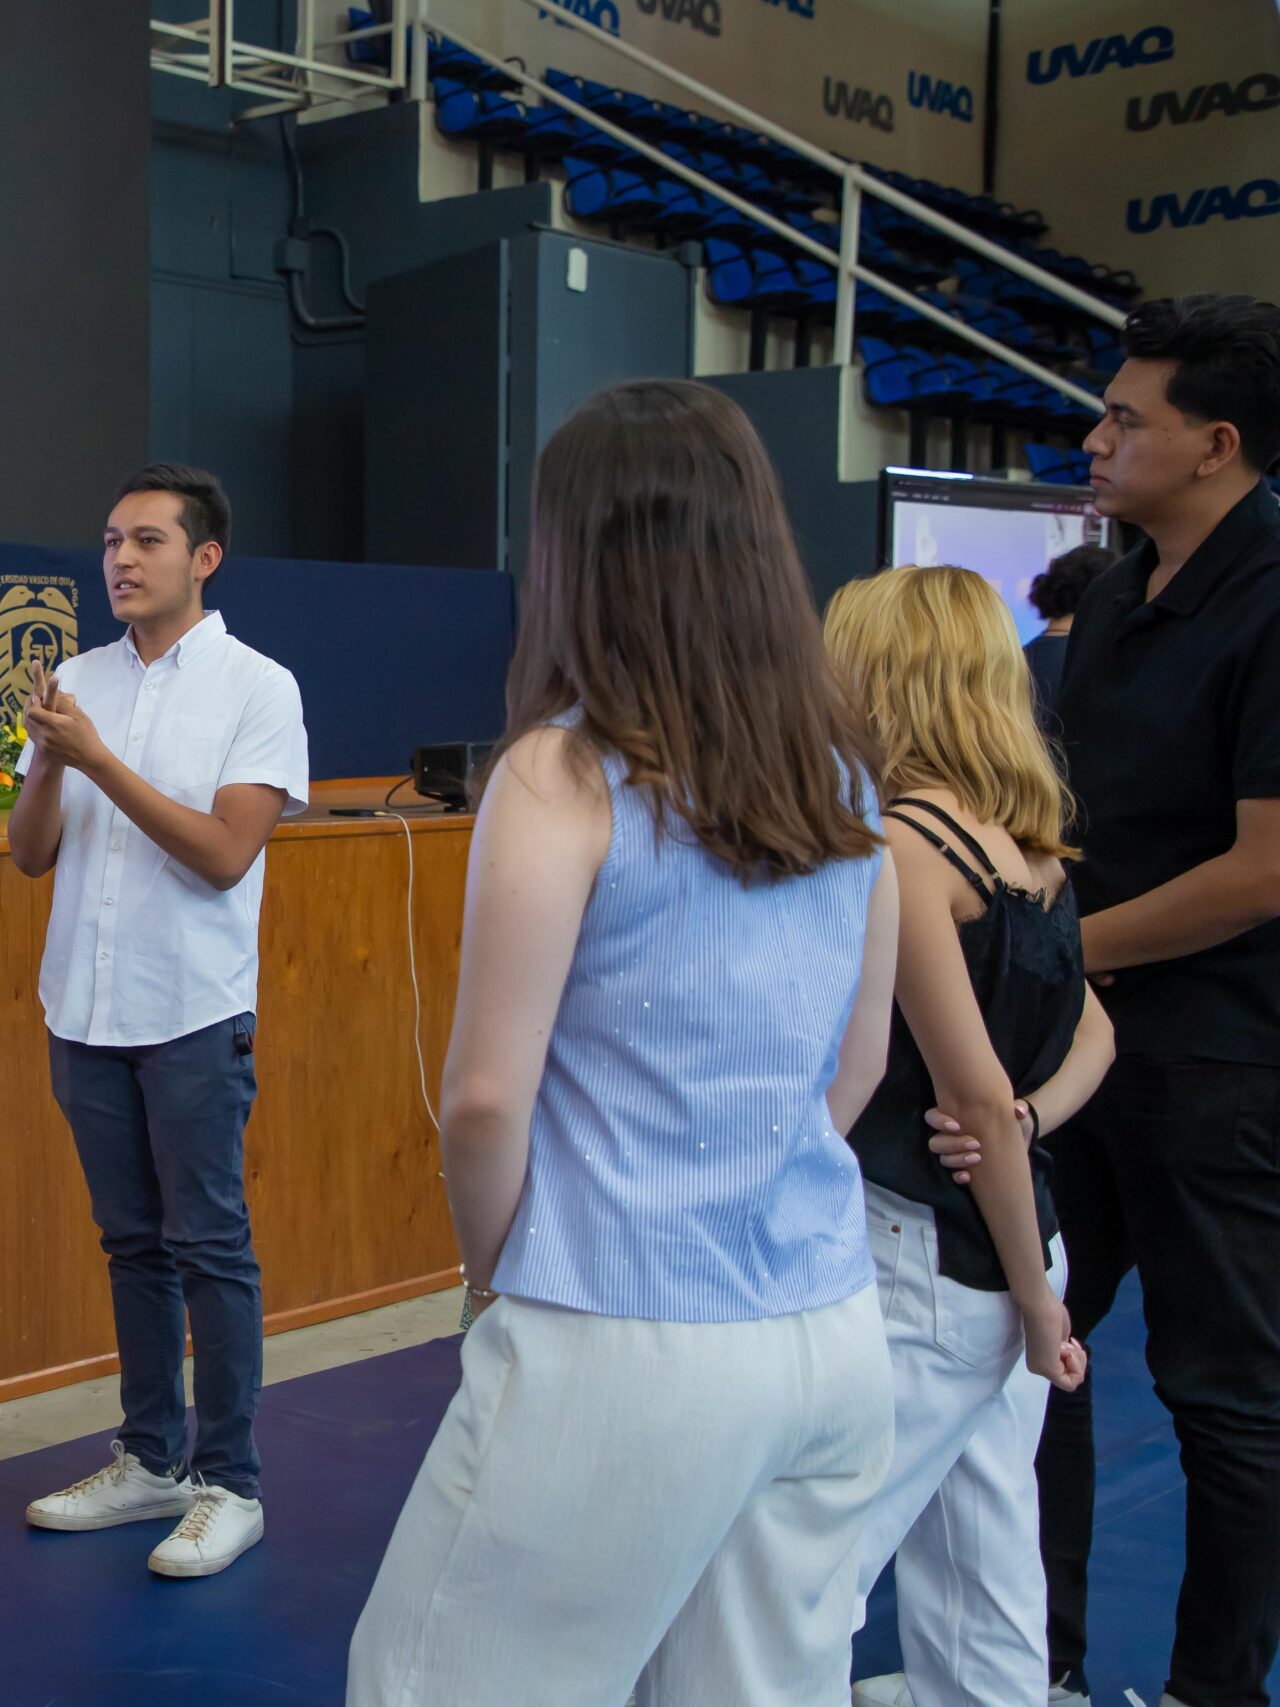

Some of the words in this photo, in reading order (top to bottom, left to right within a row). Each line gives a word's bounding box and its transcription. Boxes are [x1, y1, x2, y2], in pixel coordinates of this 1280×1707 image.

[1026, 26, 1175, 85] UVAQ
[823, 75, 894, 133] UVAQ
[907, 69, 973, 123] UVAQ
[1126, 73, 1280, 132] UVAQ
[1126, 178, 1280, 234] UVAQ
